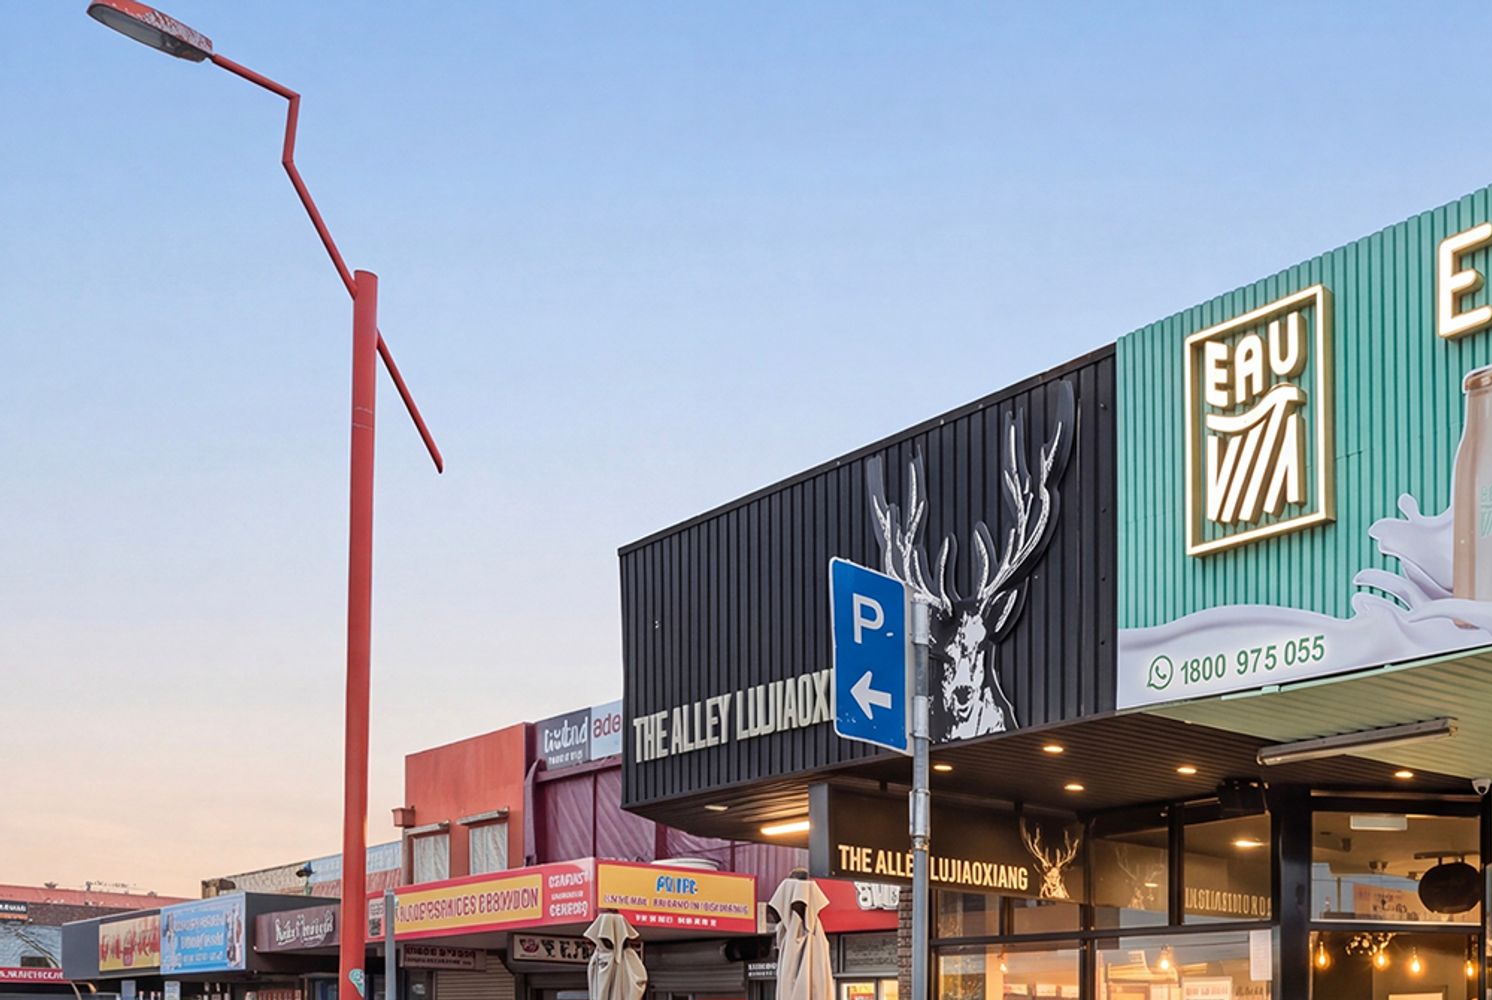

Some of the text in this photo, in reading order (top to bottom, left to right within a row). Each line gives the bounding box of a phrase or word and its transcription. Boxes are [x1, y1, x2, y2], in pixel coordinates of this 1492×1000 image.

[1204, 311, 1304, 408] EAU
[852, 592, 885, 645] P
[1180, 634, 1325, 685] 1800 975 055
[633, 709, 668, 763] THE
[671, 692, 732, 755] ALLEY
[736, 668, 835, 741] LUJIAOXI
[838, 844, 1029, 891] THE ALLE LUJIAOXIANG
